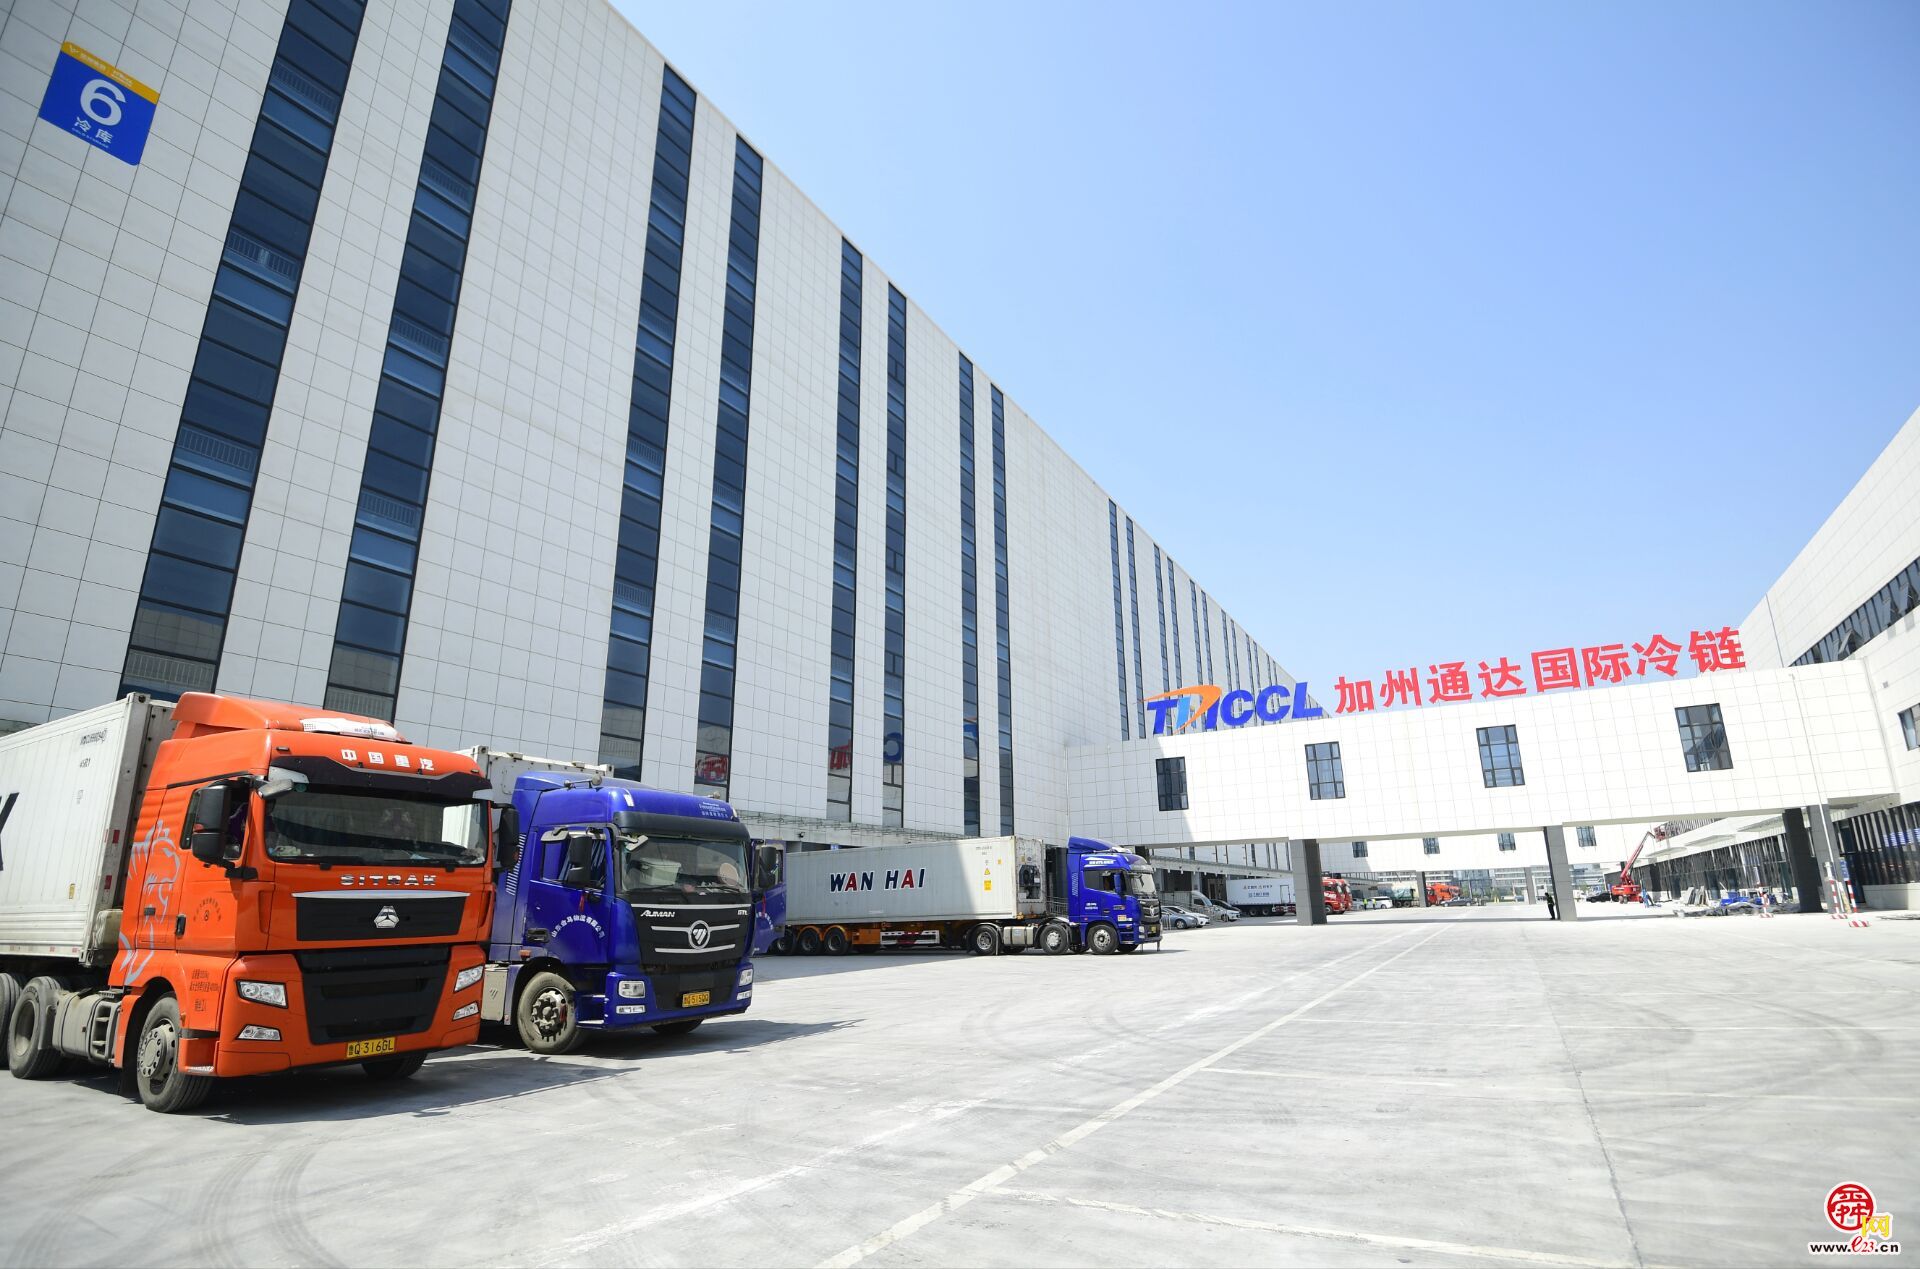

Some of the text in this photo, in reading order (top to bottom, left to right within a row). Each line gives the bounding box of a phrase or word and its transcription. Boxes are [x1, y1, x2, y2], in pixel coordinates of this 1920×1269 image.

[80, 79, 126, 126] 6
[74, 117, 113, 144] 冷库
[1334, 626, 1747, 714] 加州通达国际冷链
[340, 874, 437, 886] SITRAK
[830, 868, 926, 893] WAN HAI
[640, 909, 676, 918] AUMAN
